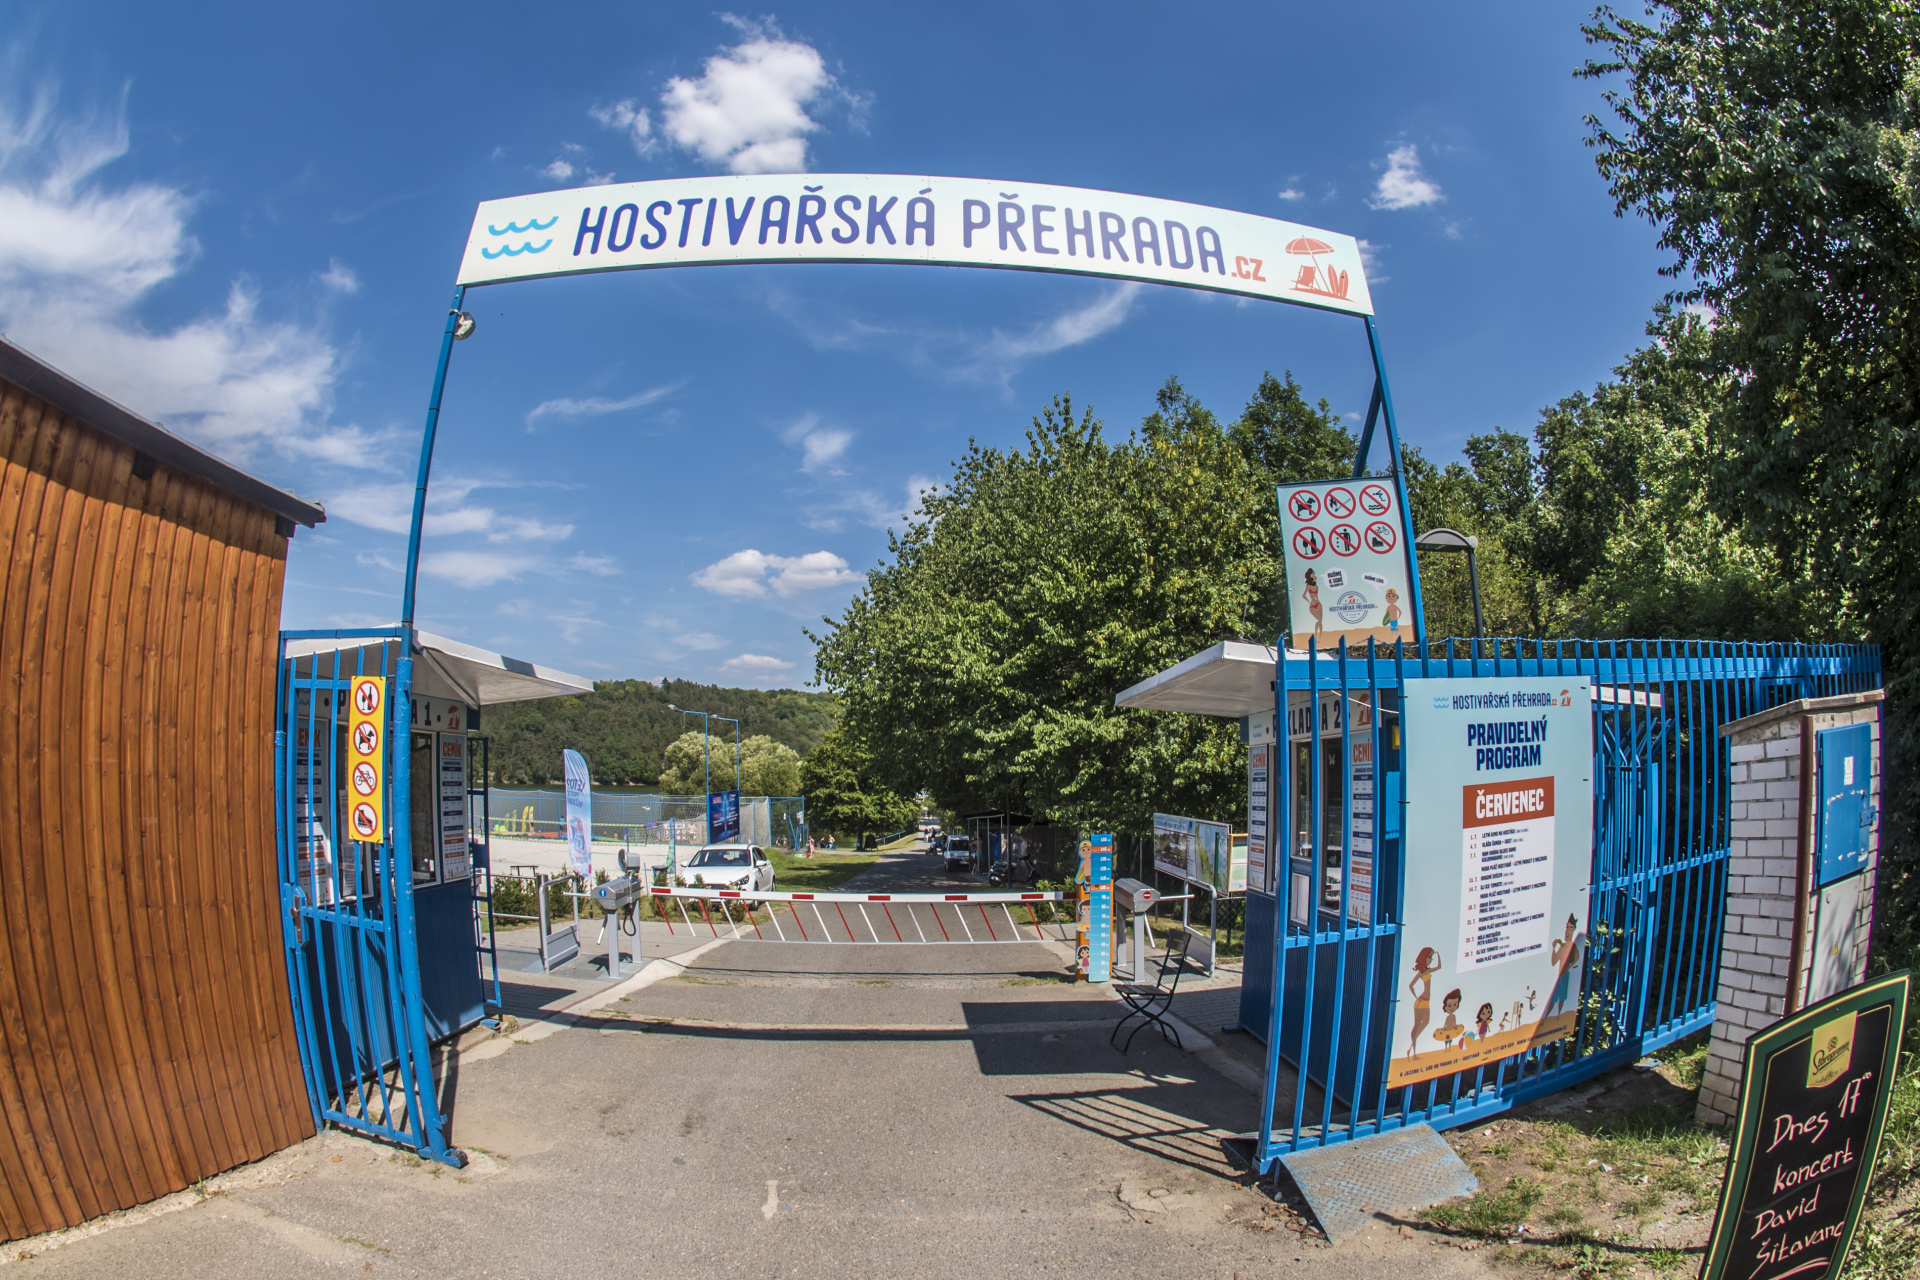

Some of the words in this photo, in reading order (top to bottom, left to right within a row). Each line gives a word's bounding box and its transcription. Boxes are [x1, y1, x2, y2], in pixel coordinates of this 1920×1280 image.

[573, 186, 935, 257] HOSTIVAŘSKÁ
[1333, 700, 1341, 728] 2
[1452, 691, 1509, 710] HOSTIVAŘSKÁ
[1467, 714, 1547, 747] PRAVIDELNÝ
[443, 739, 462, 757] CENÍK
[1476, 744, 1541, 771] PROGRAM
[1475, 788, 1544, 819] ČERVENEC
[1766, 1112, 1829, 1153] Dnes
[1773, 1138, 1854, 1194] koncert
[1751, 1183, 1821, 1239] David
